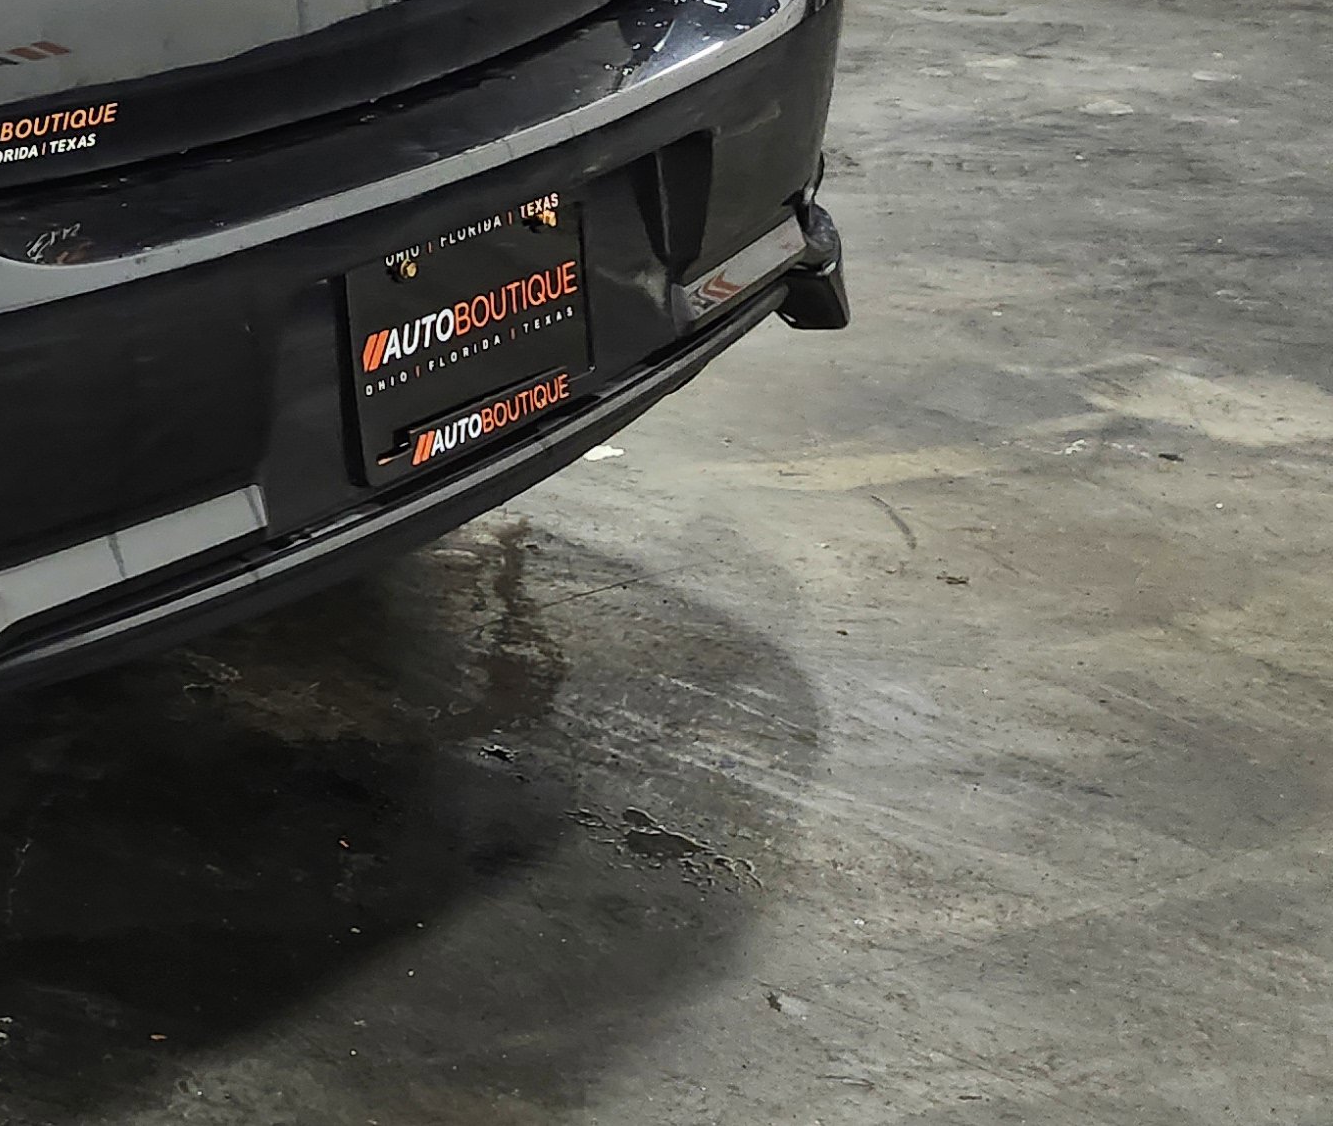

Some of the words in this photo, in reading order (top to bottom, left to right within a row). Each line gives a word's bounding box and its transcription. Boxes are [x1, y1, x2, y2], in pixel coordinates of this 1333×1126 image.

[49, 133, 97, 154] TEXAS
[519, 192, 559, 219] TEXAS
[365, 370, 408, 396] OHIO
[428, 334, 501, 371] FLORIDA
[522, 306, 574, 333] TEXAS
[382, 260, 578, 364] AUTOBOUTIQUE
[430, 373, 571, 456] AUTOBOUTIQUE
